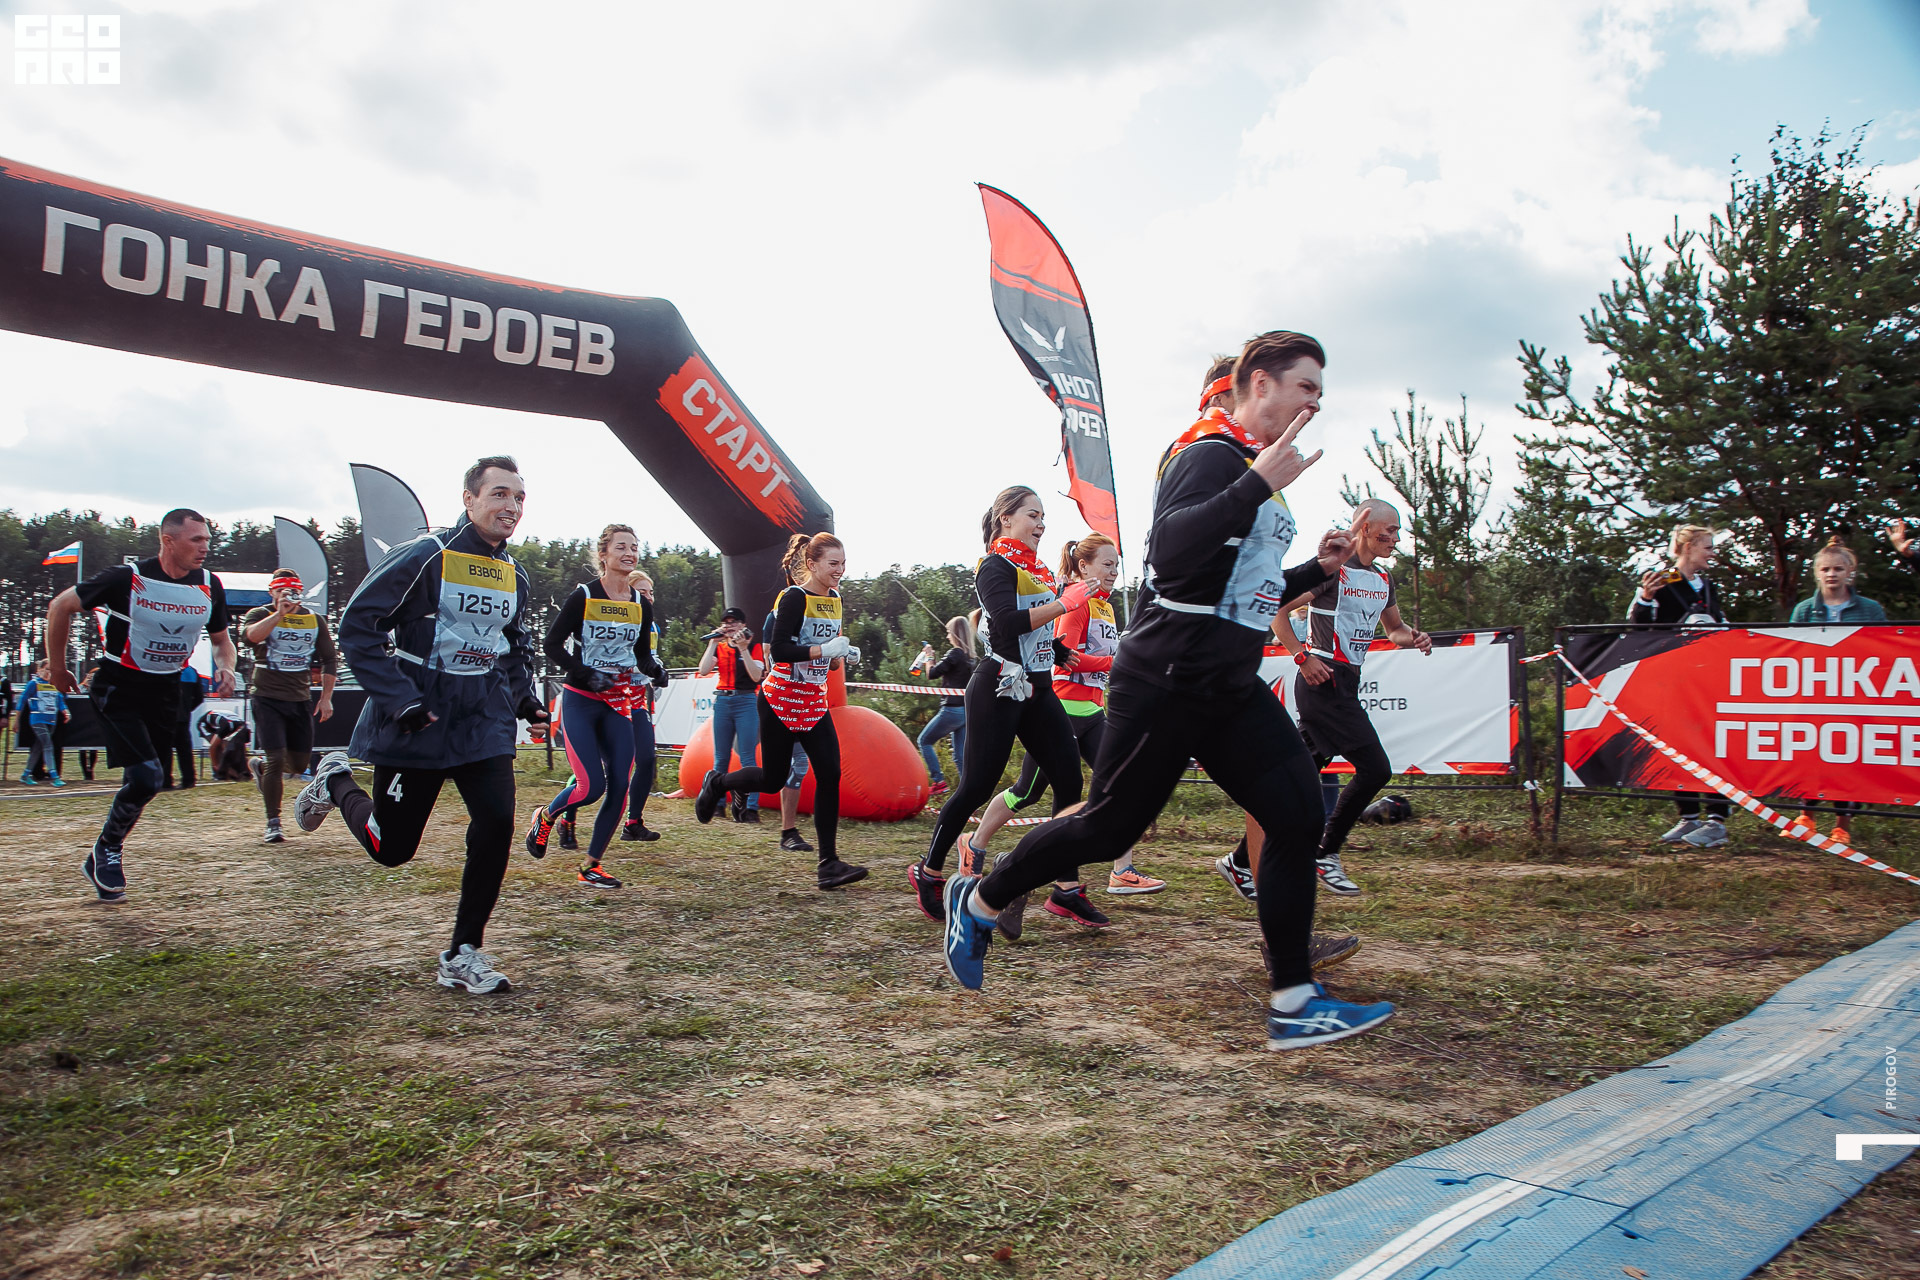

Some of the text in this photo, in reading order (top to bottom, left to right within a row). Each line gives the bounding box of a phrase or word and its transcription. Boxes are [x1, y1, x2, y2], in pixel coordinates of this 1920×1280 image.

[42, 205, 616, 376] ГОНКА ГЕРОЕВ
[682, 378, 792, 498] СТАРТ
[468, 564, 504, 583] ВЗВОД
[1343, 586, 1388, 600] ИНСТРУКТОР
[136, 596, 208, 615] ИНСТРУКТОР
[457, 592, 511, 618] 125-8
[601, 605, 628, 617] ВЗВОД
[277, 630, 312, 642] 125-6
[589, 625, 636, 642] 125-10
[149, 640, 188, 651] ГОНКА
[1729, 656, 1920, 699] ГОНКА
[386, 772, 404, 802] 4
